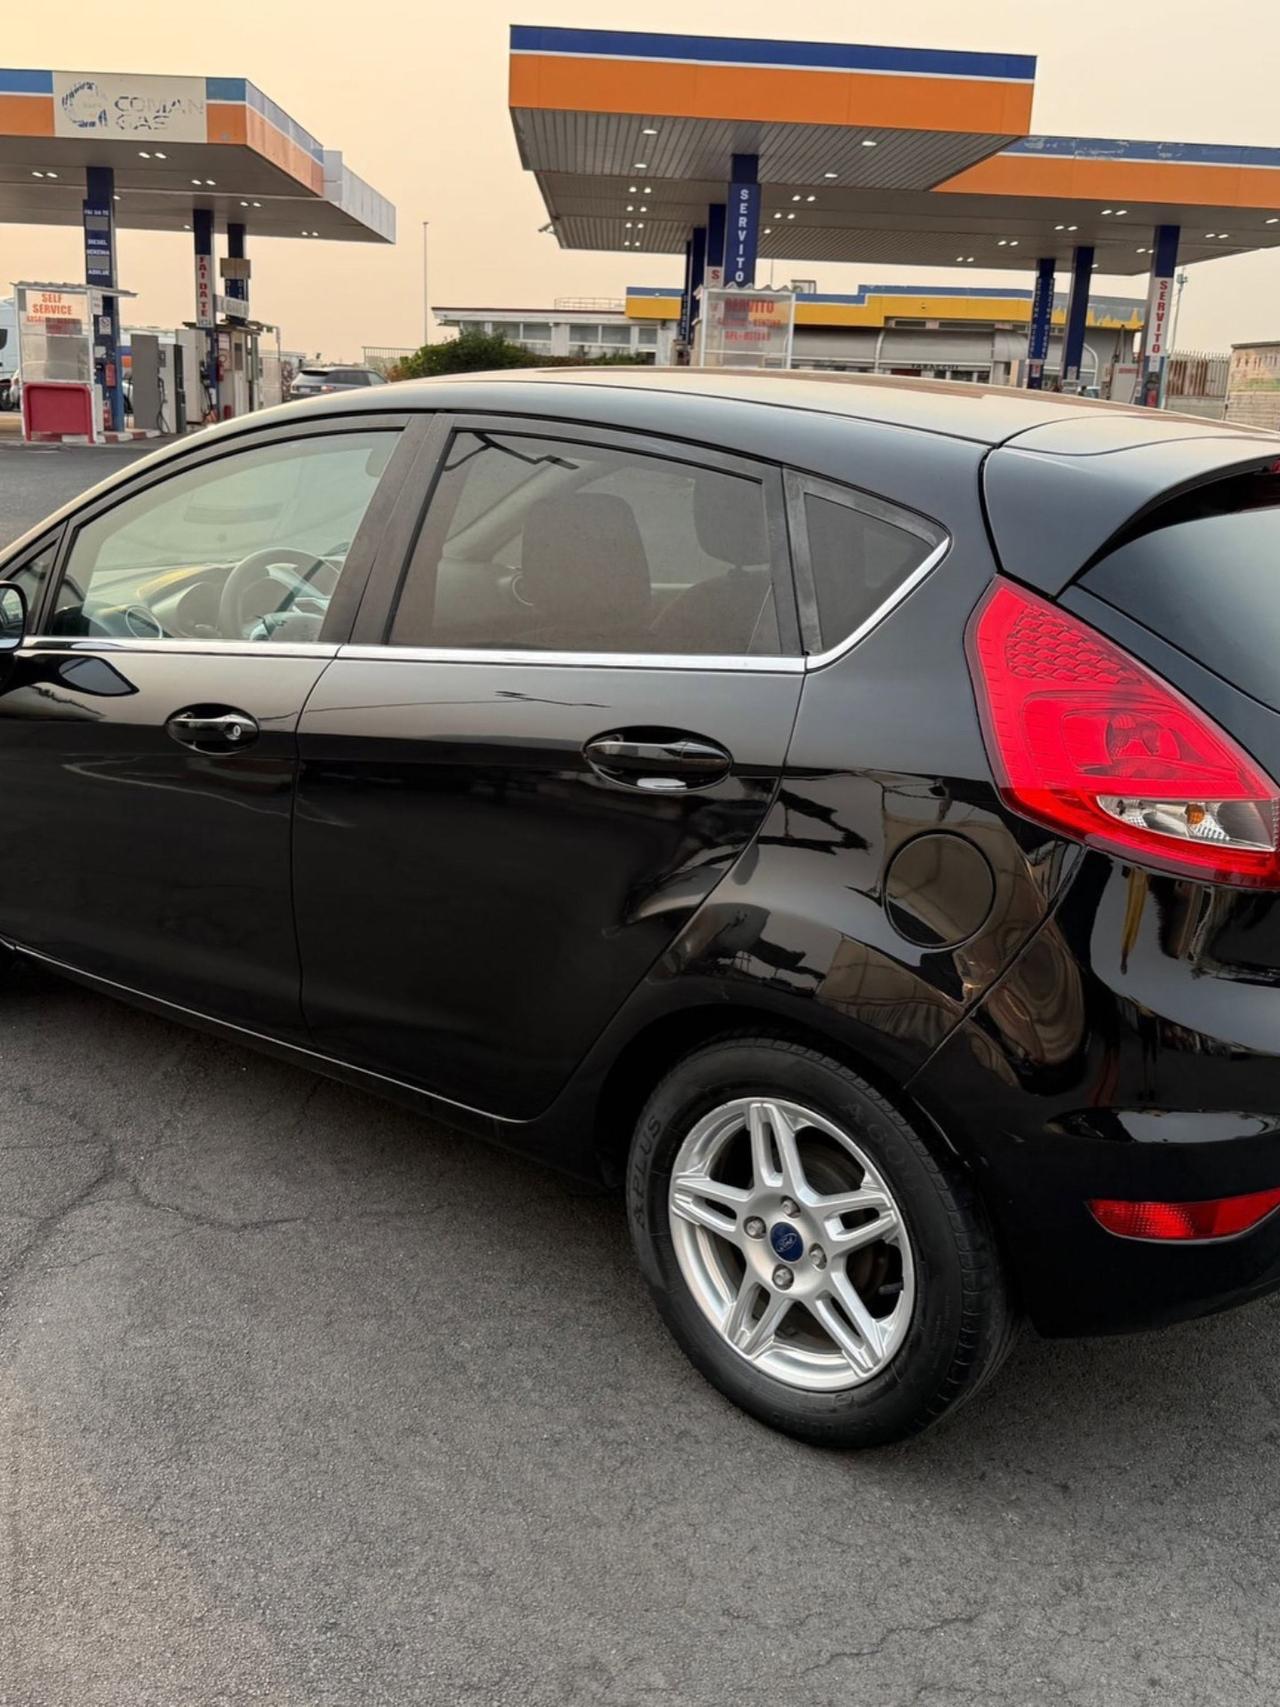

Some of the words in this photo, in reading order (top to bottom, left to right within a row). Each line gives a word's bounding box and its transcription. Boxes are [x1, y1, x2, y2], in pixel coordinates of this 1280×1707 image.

[735, 189, 749, 282] SERVITO
[199, 256, 207, 279] FAI
[41, 293, 62, 304] SELF
[199, 283, 207, 298] DA
[32, 303, 73, 315] SERVICE
[201, 302, 208, 317] TE
[1152, 281, 1168, 354] SERVITO
[632, 1114, 661, 1231] APLUS
